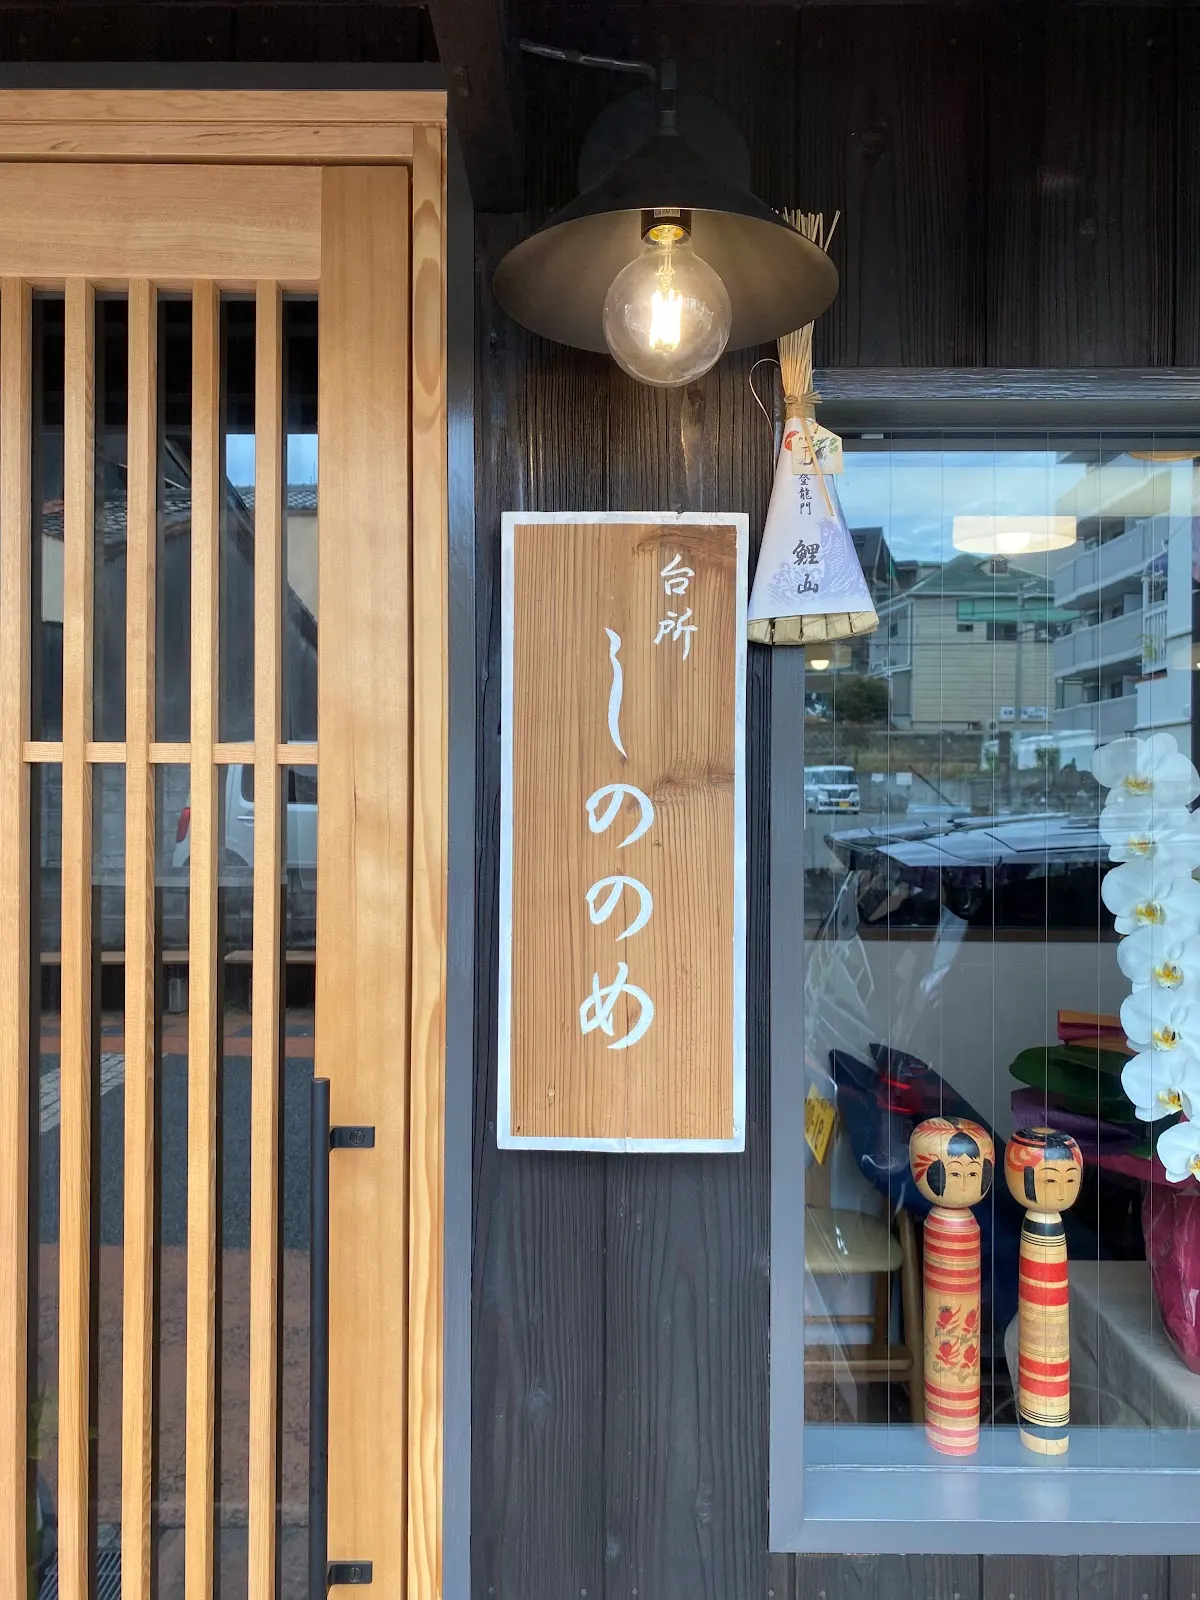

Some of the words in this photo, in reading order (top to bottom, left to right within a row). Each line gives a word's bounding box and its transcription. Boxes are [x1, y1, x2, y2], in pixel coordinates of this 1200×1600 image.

[653, 553, 698, 661] 台所
[792, 539, 821, 595] 鯉山
[579, 626, 655, 1050] しののめ
